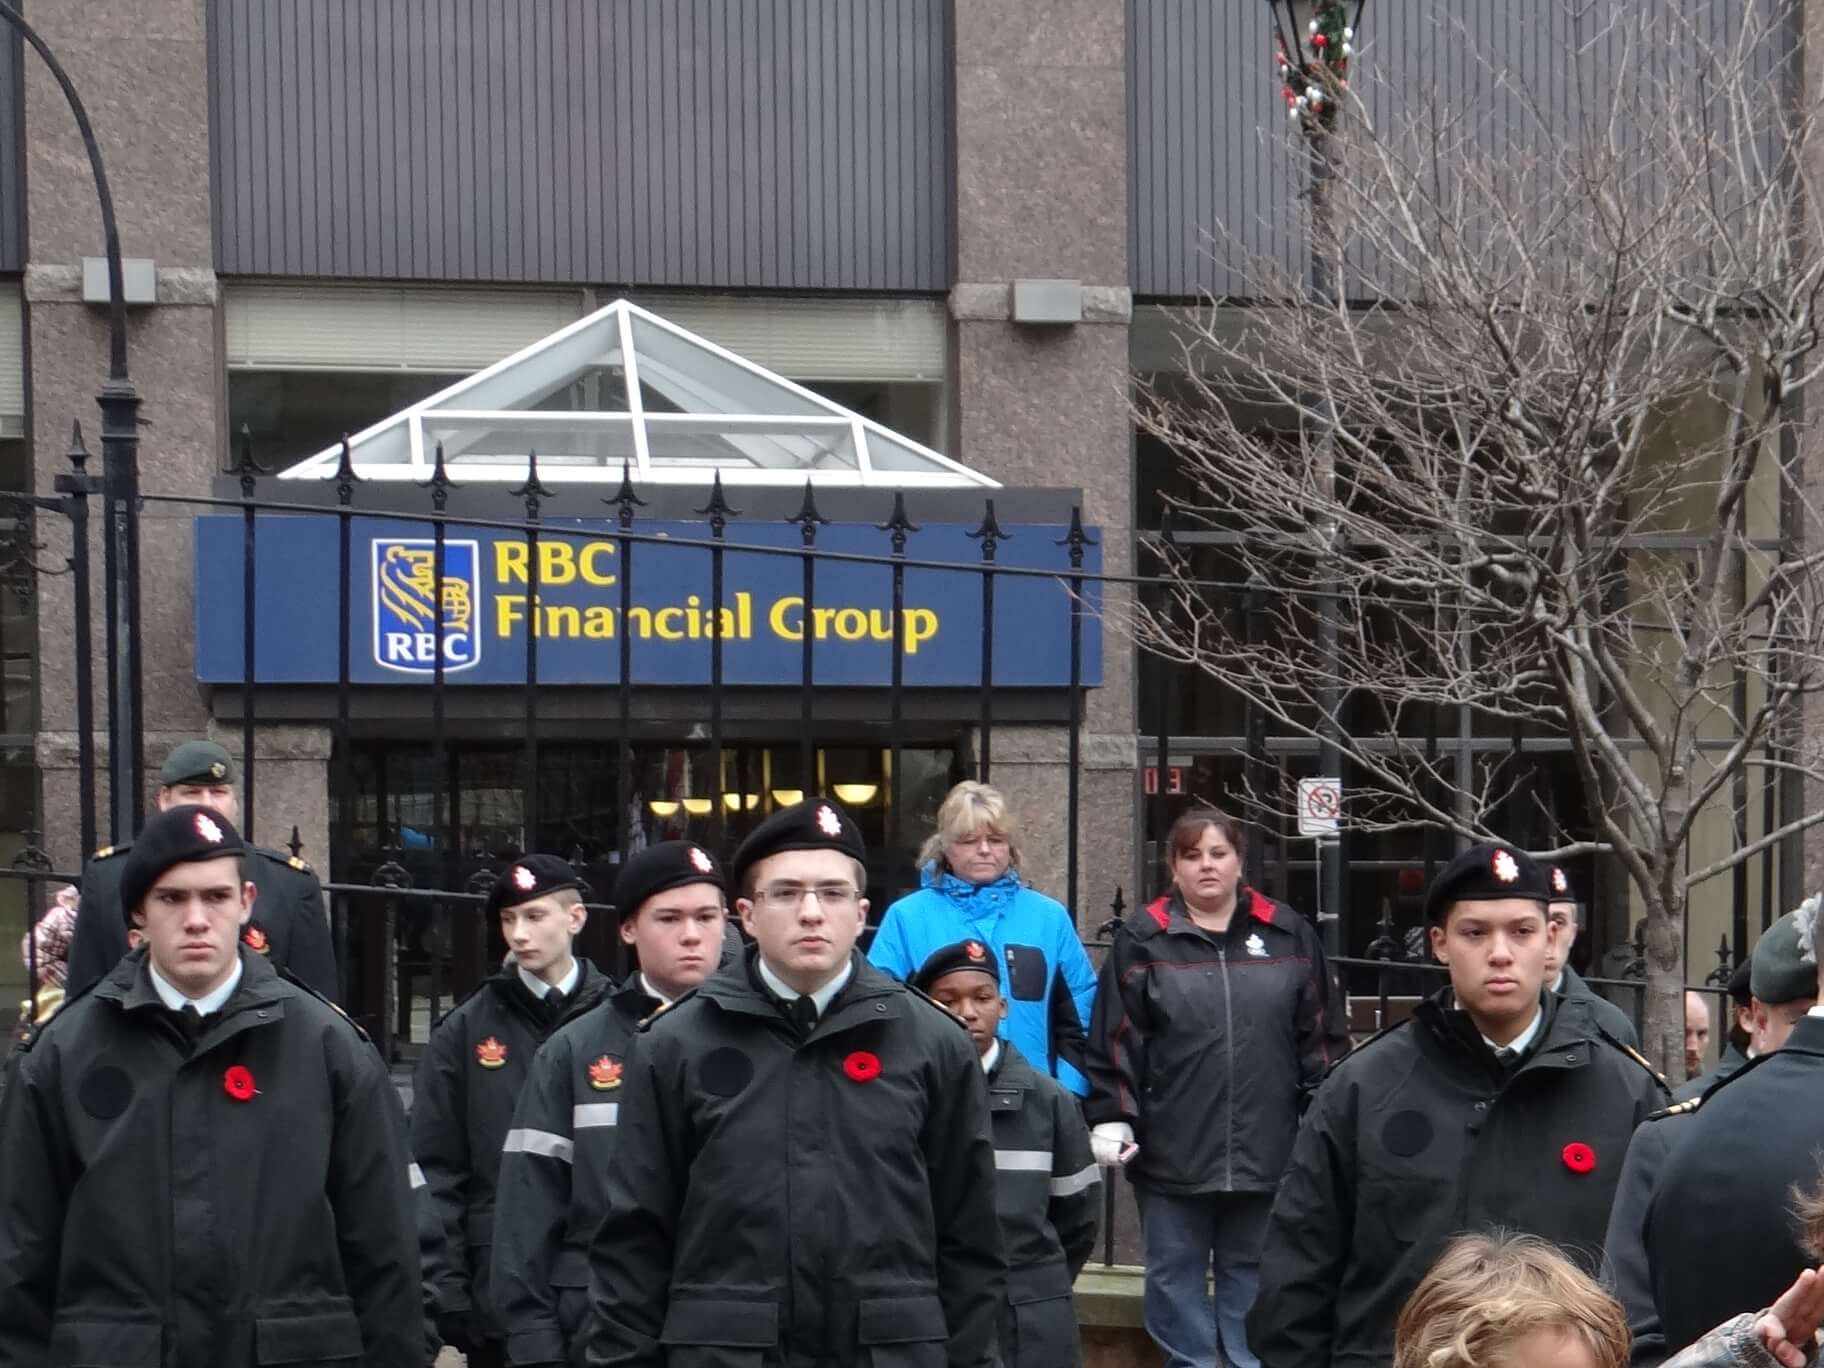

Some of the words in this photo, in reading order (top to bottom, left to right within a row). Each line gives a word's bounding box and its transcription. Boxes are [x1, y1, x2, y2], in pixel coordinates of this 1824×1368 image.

[494, 541, 616, 585] RBC
[494, 591, 752, 639] Financial
[769, 597, 938, 654] Group
[386, 632, 468, 661] RBC
